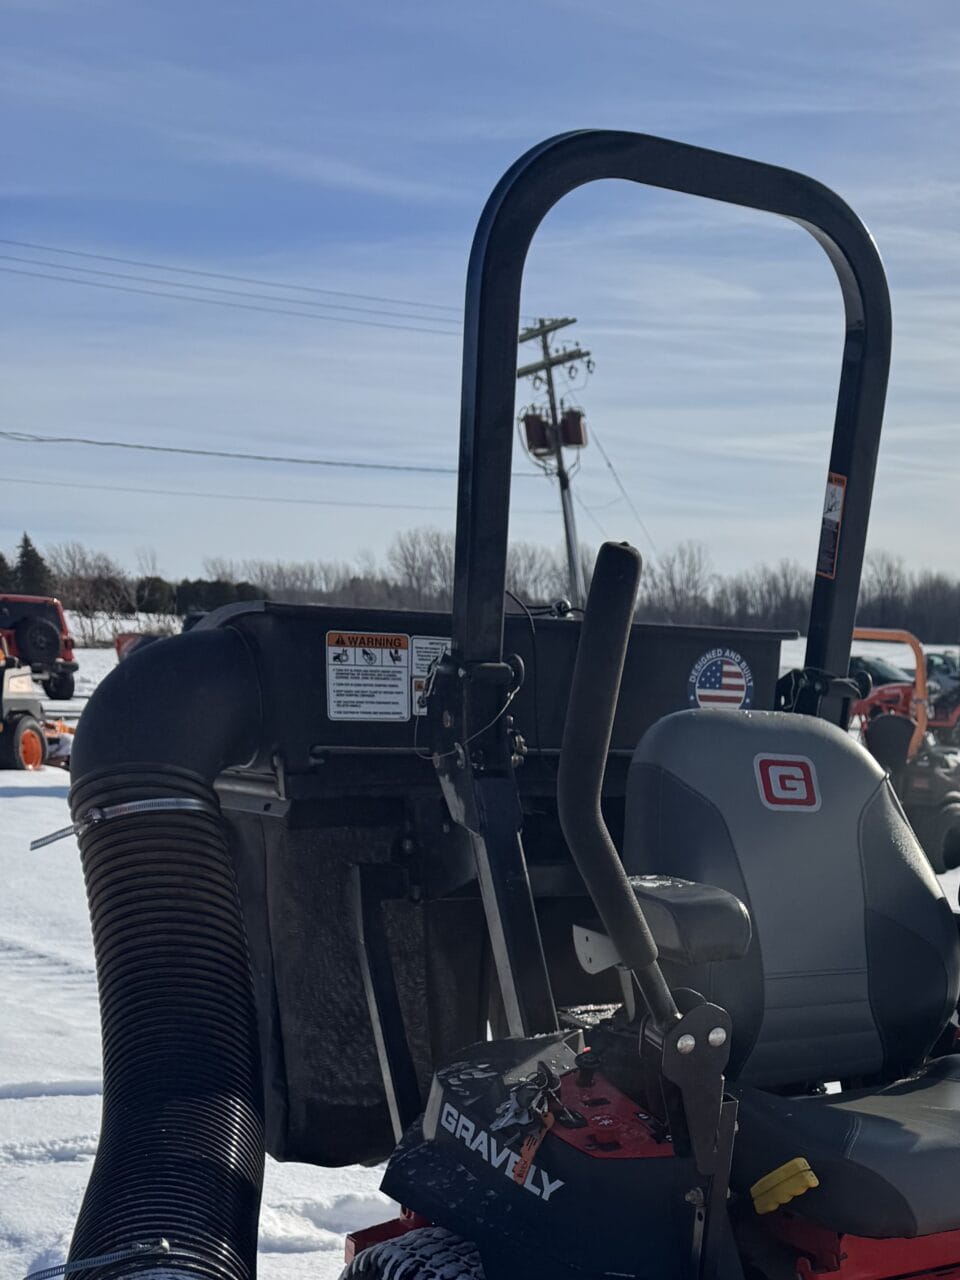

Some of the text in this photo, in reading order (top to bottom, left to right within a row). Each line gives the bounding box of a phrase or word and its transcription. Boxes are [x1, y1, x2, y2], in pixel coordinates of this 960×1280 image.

[347, 636, 401, 647] WARNING
[689, 648, 754, 687] DESIGNED AND BUILT
[440, 1102, 565, 1201] GRAVELY
